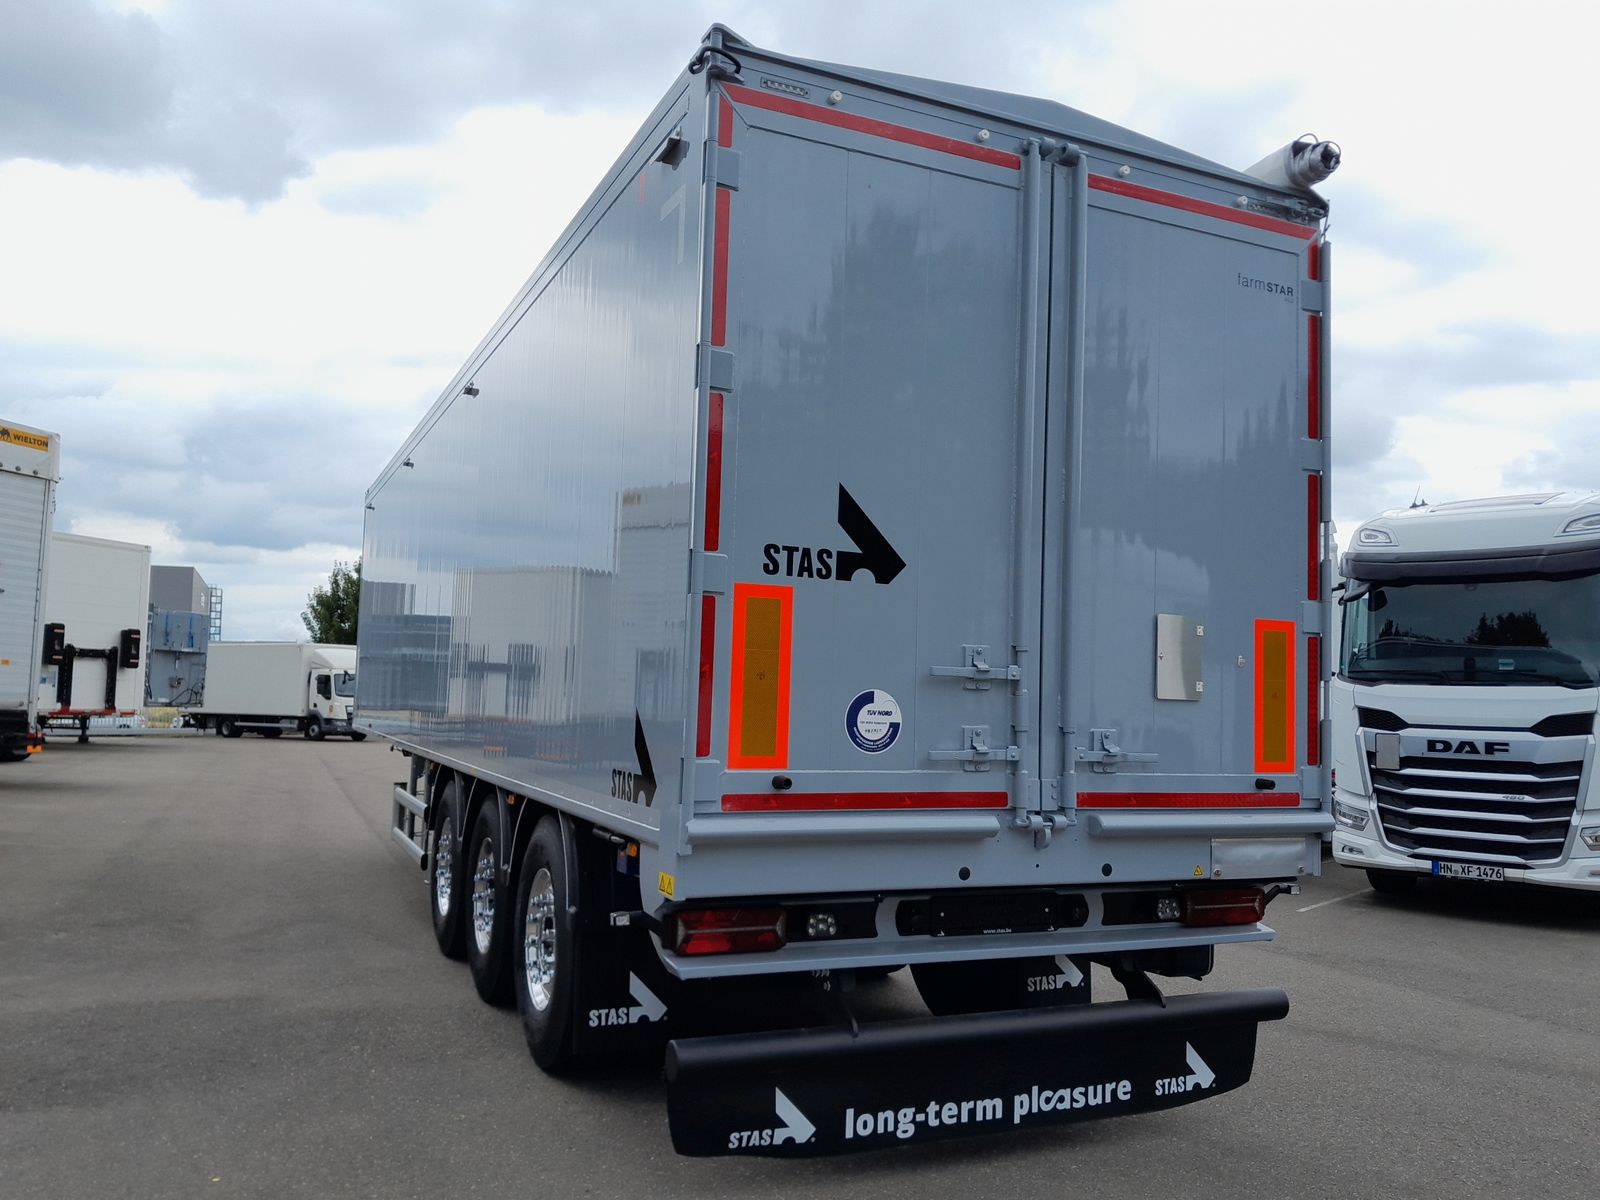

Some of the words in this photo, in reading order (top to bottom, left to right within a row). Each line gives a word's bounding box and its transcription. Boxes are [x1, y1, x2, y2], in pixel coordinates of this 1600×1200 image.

[1237, 272, 1294, 296] farmSTAR
[13, 433, 48, 447] WIELTON
[763, 543, 833, 580] STAS
[1427, 739, 1510, 755] DAF
[611, 768, 633, 802] STAS
[1440, 863, 1453, 874] HN
[1460, 865, 1473, 876] XF
[1476, 866, 1502, 879] 1476
[1027, 975, 1056, 992] STAS
[588, 1007, 628, 1027] STAS
[1155, 1075, 1186, 1096] STAS
[845, 1096, 1004, 1139] long-term
[728, 1129, 773, 1149] STAS
